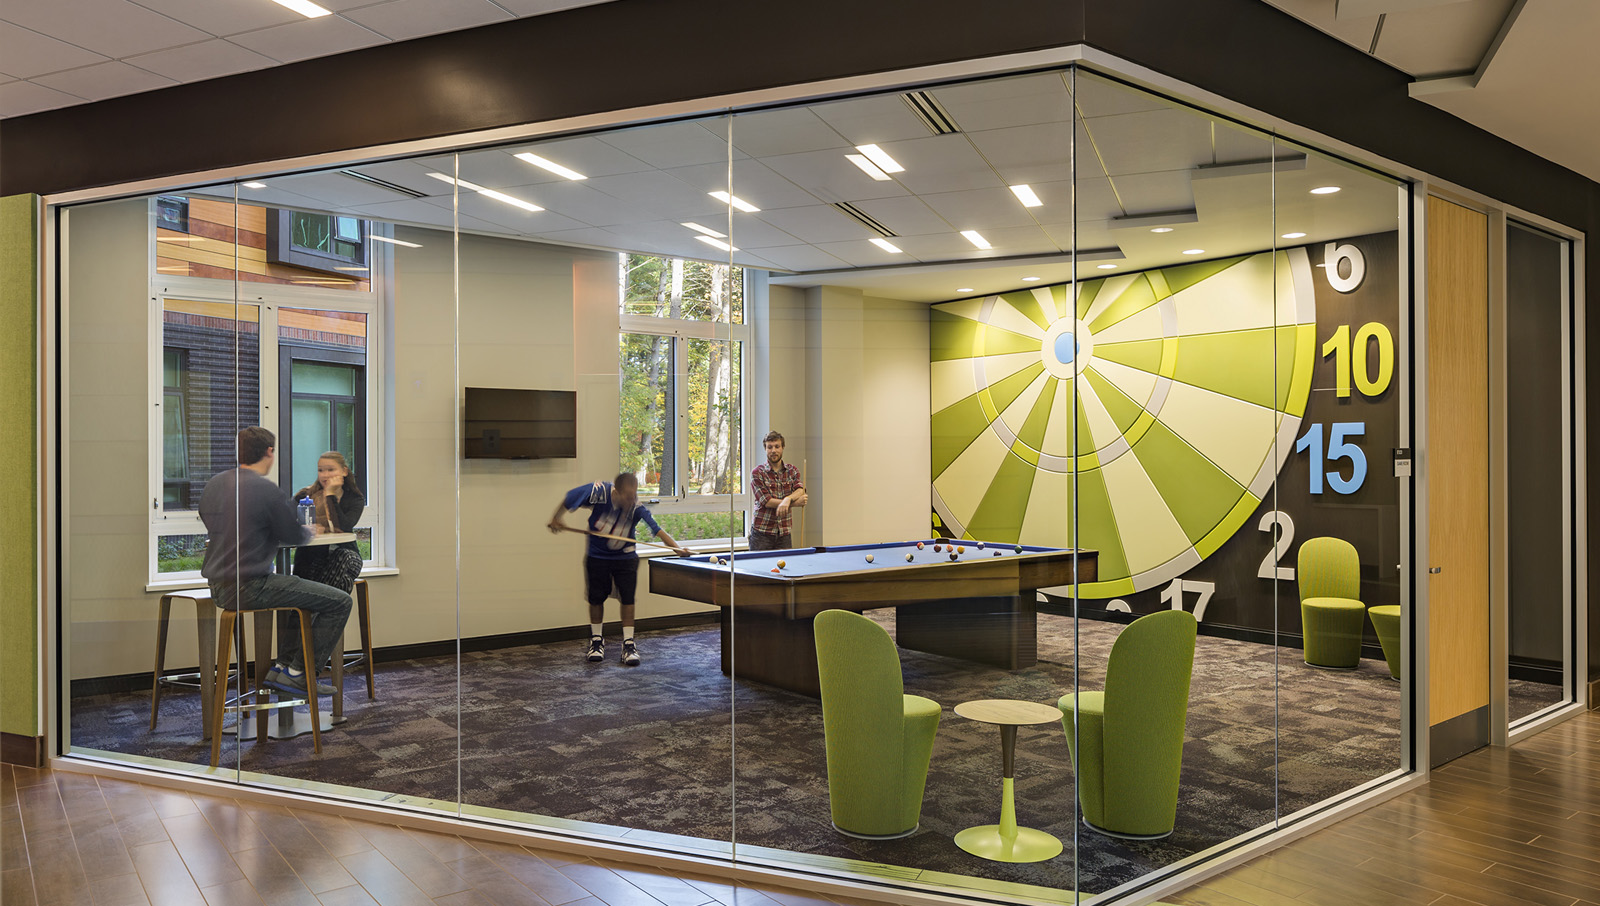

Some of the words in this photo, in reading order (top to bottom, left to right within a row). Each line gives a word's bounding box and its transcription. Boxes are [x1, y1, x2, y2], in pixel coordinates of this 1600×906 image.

[1324, 242, 1365, 293] 6
[1322, 321, 1394, 398] 10
[1296, 422, 1368, 495] 15
[1257, 510, 1296, 581] 2
[1160, 578, 1216, 623] 17
